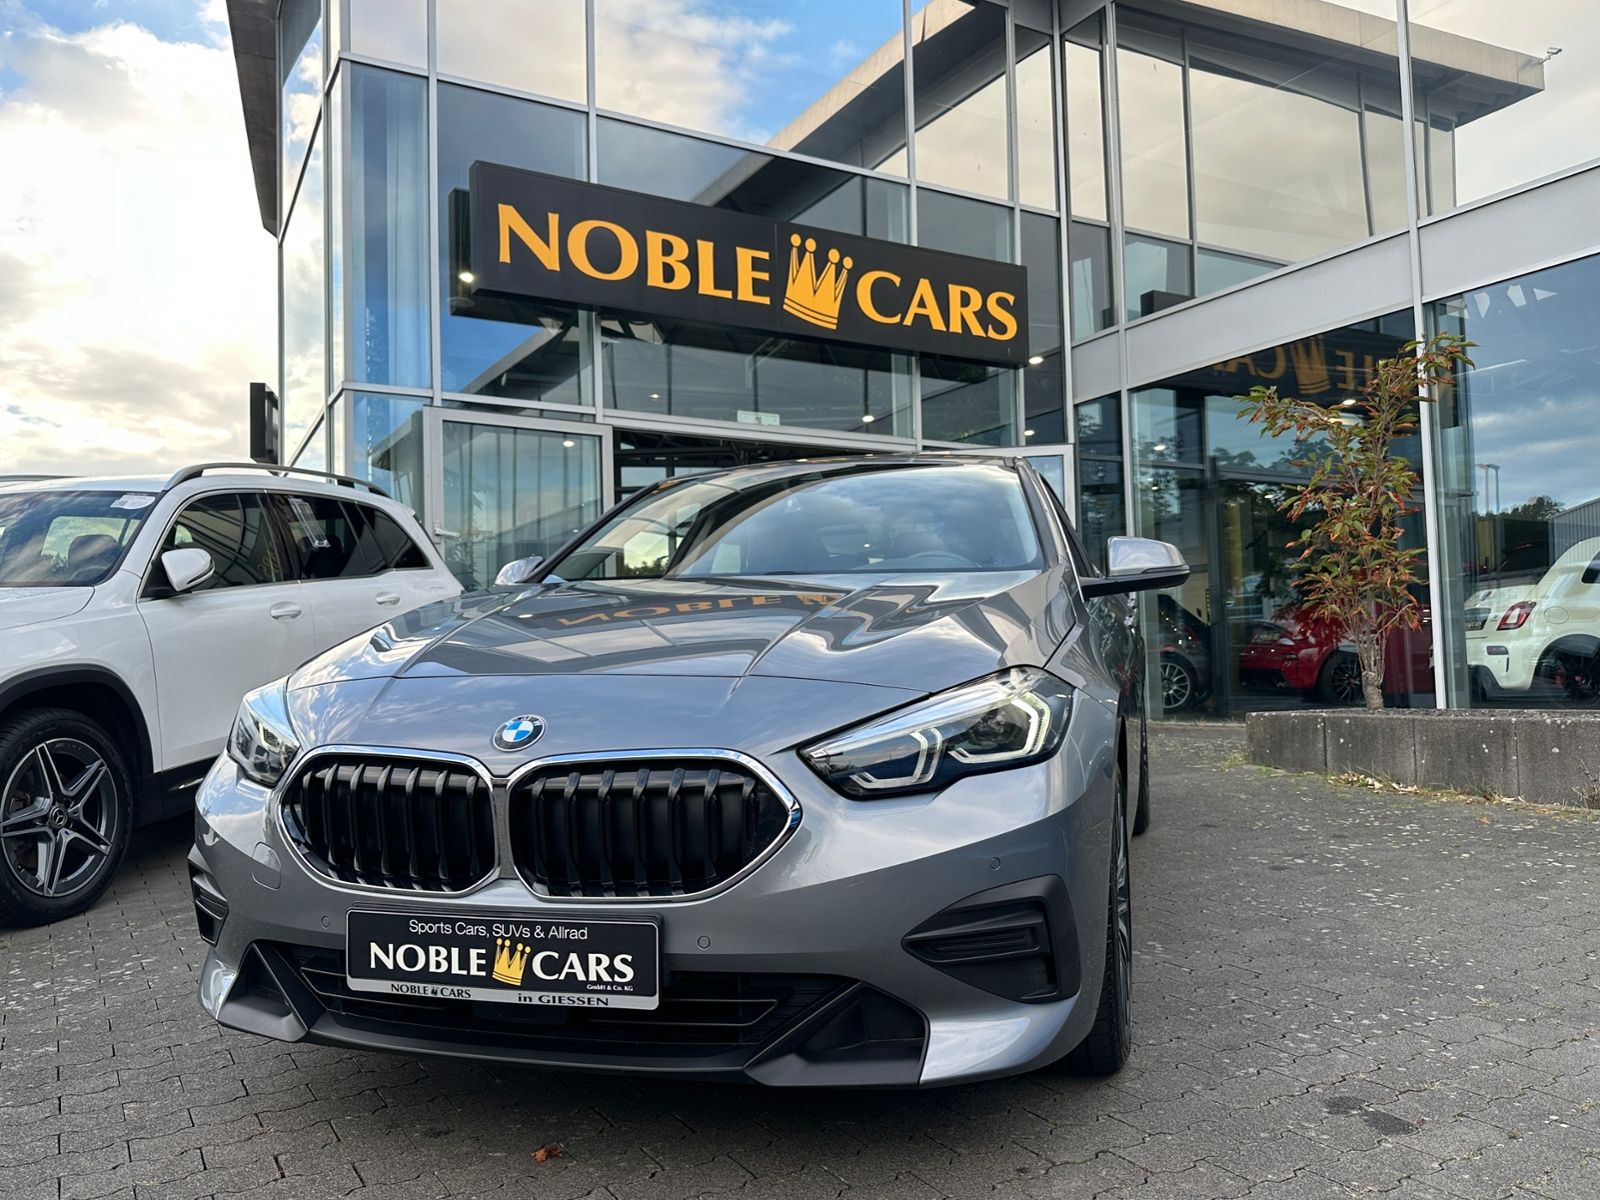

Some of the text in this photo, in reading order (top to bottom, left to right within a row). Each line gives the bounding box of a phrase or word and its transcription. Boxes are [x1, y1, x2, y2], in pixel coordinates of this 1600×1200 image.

[498, 203, 1018, 341] NOBLE CARS
[409, 919, 588, 940] Sports Cars, SUVs & Allrad
[370, 942, 635, 983] NOBLE CARS
[391, 983, 471, 999] NOBLE CARS
[518, 993, 609, 1006] in GIESSEN
